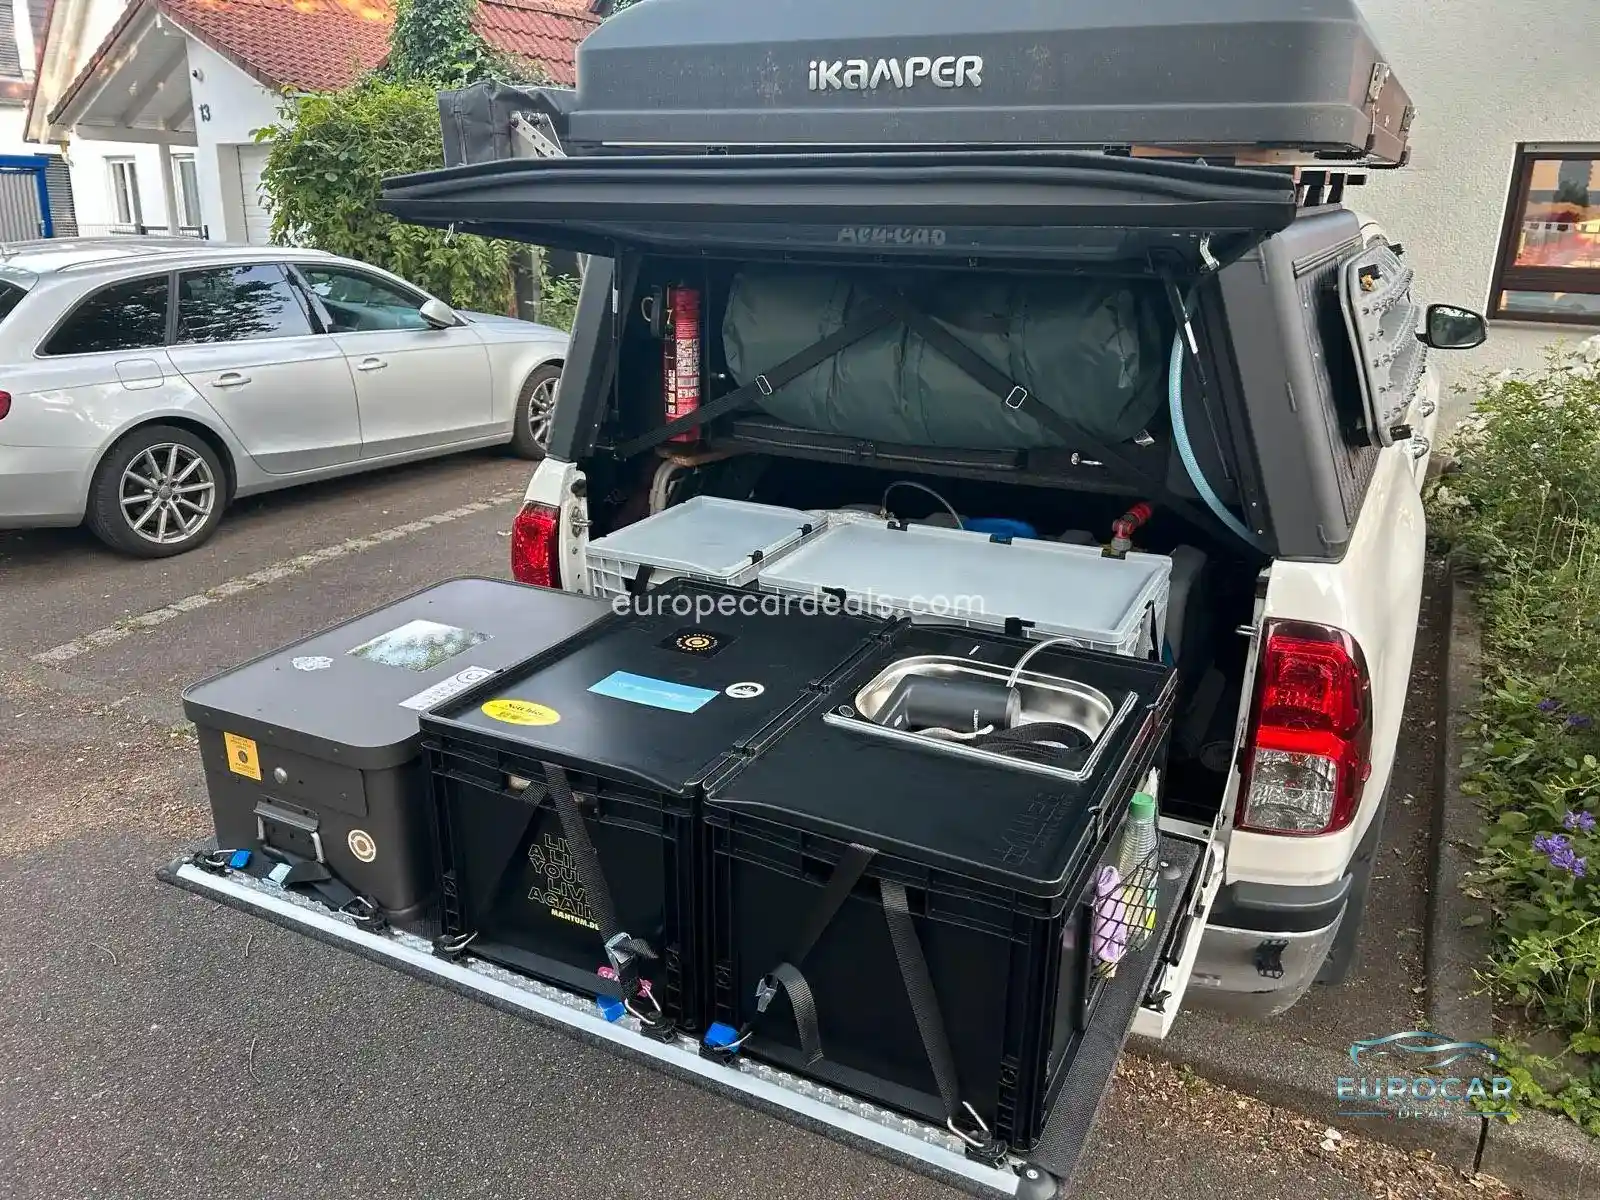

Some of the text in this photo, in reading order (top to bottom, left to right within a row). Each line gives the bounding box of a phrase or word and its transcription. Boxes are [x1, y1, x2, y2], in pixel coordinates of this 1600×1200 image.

[200, 104, 211, 121] 13
[528, 844, 546, 861] A
[530, 854, 583, 884] YOU
[548, 878, 590, 904] LIV
